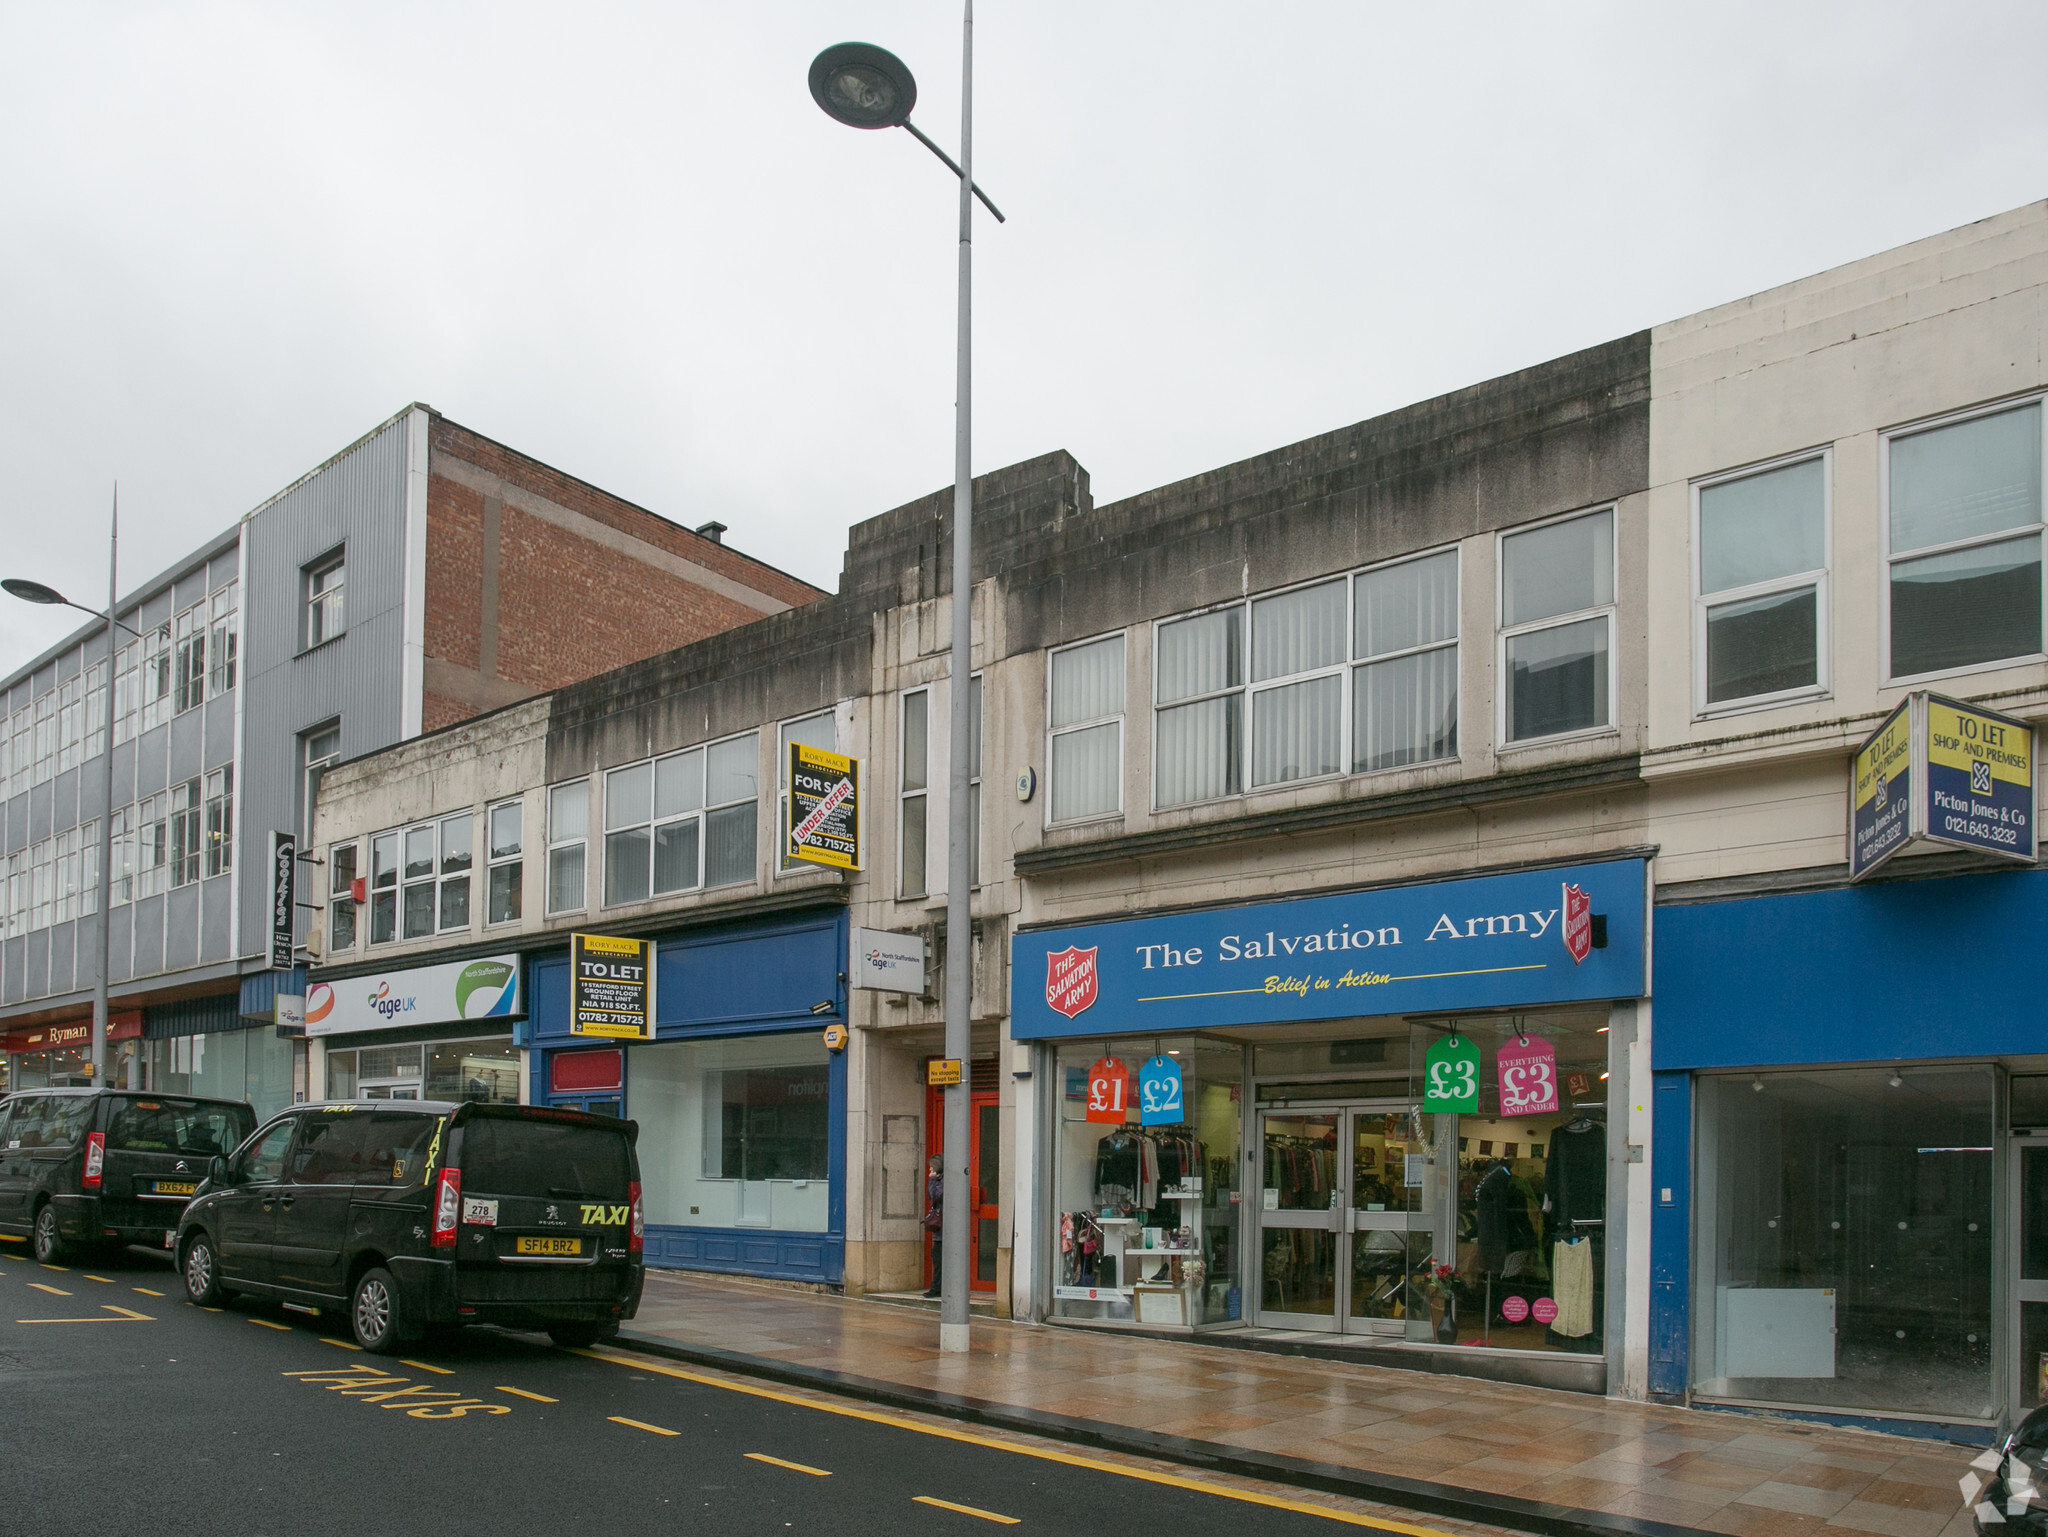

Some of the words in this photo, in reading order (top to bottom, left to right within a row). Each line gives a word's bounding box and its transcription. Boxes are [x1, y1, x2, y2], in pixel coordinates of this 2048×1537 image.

[1957, 715, 1978, 740] TO
[1982, 723, 2006, 747] LET
[1869, 743, 1880, 767] TO
[1882, 727, 1895, 755] LET
[1933, 733, 1960, 751] SHOP
[1963, 742, 1984, 758] AND
[1986, 747, 2027, 770] PREMISES
[804, 752, 823, 763] RORY
[825, 758, 845, 768] MACK
[1858, 772, 1871, 793] SHOP
[1873, 763, 1883, 780] AND
[1883, 738, 1908, 767] PREMISES
[795, 774, 822, 792] FOR
[824, 782, 855, 800] SE
[796, 809, 825, 840] UNDER
[824, 783, 850, 811] OFFER
[1934, 790, 1969, 813] Picton
[1970, 799, 1999, 820] Jones
[2000, 807, 2009, 822] &
[2011, 809, 2026, 826] Co
[1857, 825, 1875, 846] Picton
[1875, 812, 1890, 835] Jones
[1891, 804, 1897, 819] &
[1897, 797, 1907, 814] Co
[1945, 816, 2017, 845] 0121.643.3232
[824, 837, 855, 853] 715725
[1571, 897, 1581, 915] THE
[590, 941, 610, 949] RORY
[613, 942, 634, 951] MACK
[1136, 943, 1203, 969] The
[1219, 923, 1402, 962] Salvation
[1424, 908, 1559, 942] Army
[581, 961, 608, 977] TO
[610, 964, 643, 980] LET
[894, 954, 920, 963] Staffordshire
[1055, 953, 1075, 977] THE
[588, 982, 619, 990] STAFFORD
[620, 984, 642, 992] STREET
[1048, 955, 1093, 1002] SALVATION
[1264, 975, 1310, 997] Belief
[1314, 976, 1330, 990] in
[1338, 967, 1391, 988] Action
[584, 988, 615, 996] GROUND
[615, 989, 639, 997] FLOOR
[1064, 975, 1092, 1010] ARMY
[582, 1000, 598, 1008] NIA
[600, 1001, 614, 1009] 918
[615, 1003, 641, 1011] SQ.FT.
[578, 1011, 608, 1022] 01782
[610, 1014, 644, 1025] 715725
[49, 1025, 87, 1044] Ryman
[1499, 1054, 1555, 1069] EVERYTHING
[1088, 1078, 1124, 1112] £1
[1143, 1076, 1181, 1113] £2
[1427, 1060, 1476, 1099] £3
[1503, 1063, 1554, 1107] £3
[323, 1105, 358, 1113] TAXI
[1505, 1105, 1523, 1115] AND
[1524, 1102, 1555, 1113] UNDER
[423, 1116, 447, 1186] TAXI
[159, 1182, 184, 1192] BX62
[472, 1205, 489, 1216] 278
[580, 1204, 630, 1225] TAXI
[524, 1238, 550, 1251] SF14
[552, 1239, 574, 1252] BRZ
[281, 1364, 512, 1419] TAXIS
